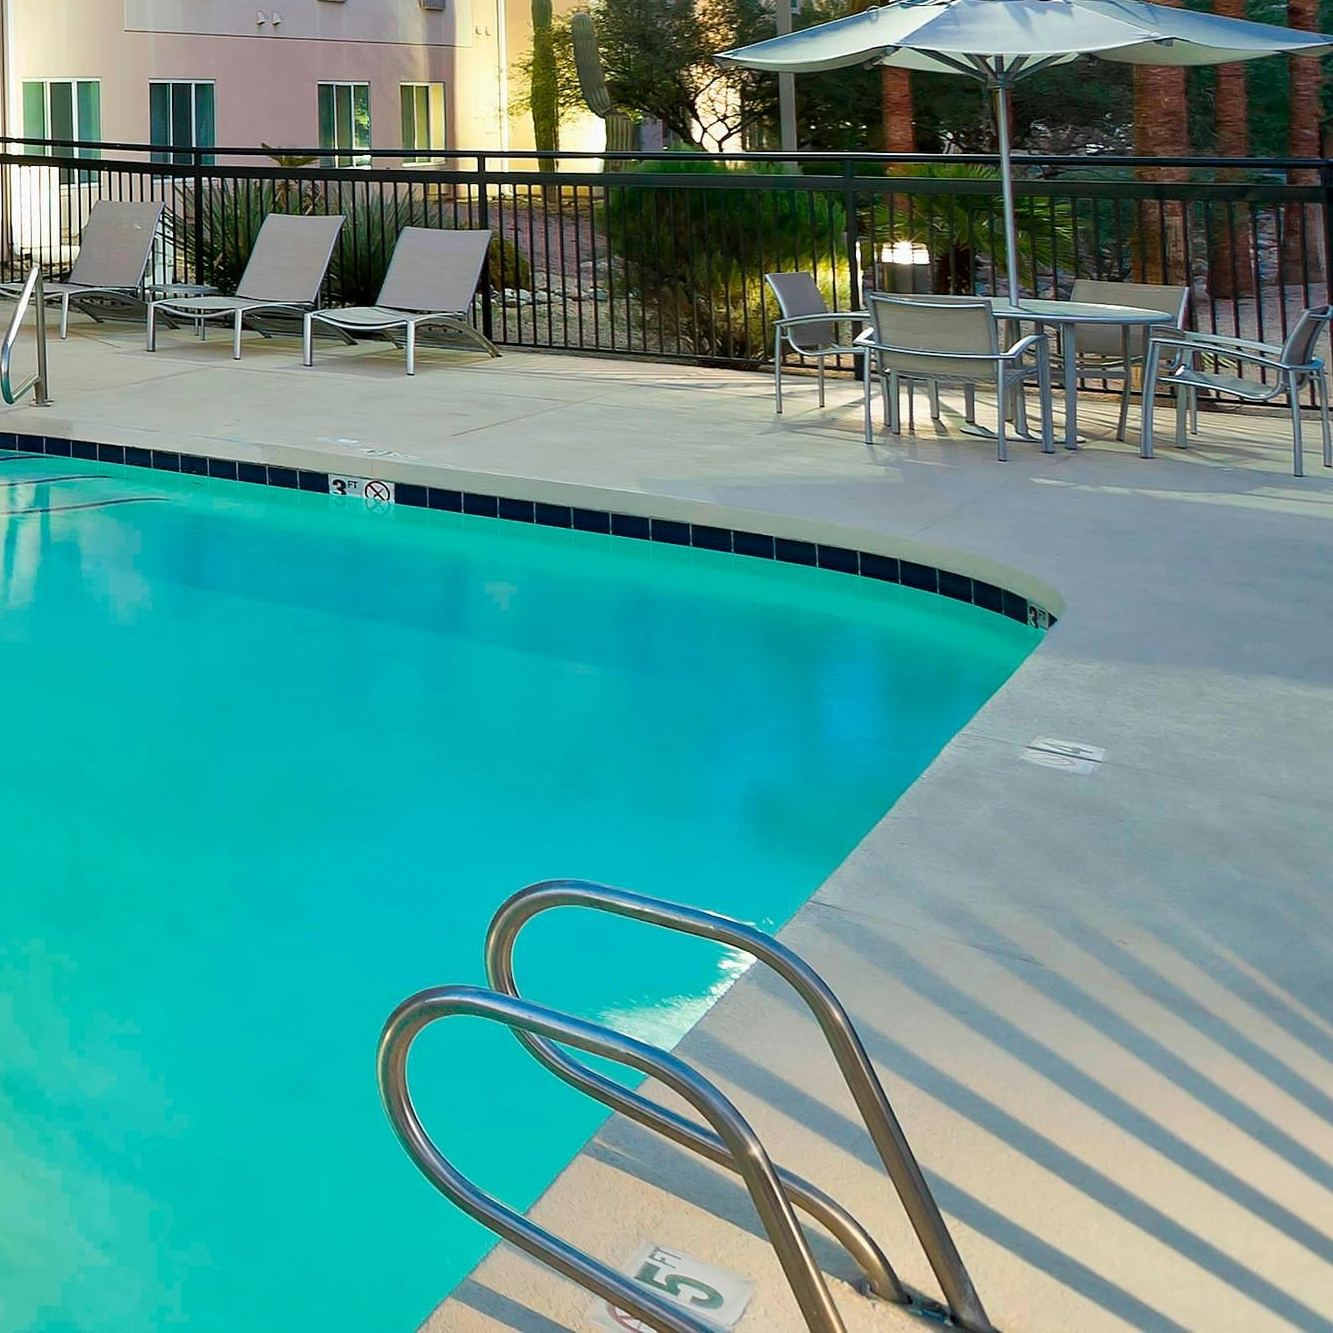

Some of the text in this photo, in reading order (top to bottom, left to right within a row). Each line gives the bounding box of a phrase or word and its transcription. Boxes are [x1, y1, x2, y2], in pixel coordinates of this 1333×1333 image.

[332, 479, 359, 495] 3 FT
[635, 1246, 725, 1310] 5 FT
